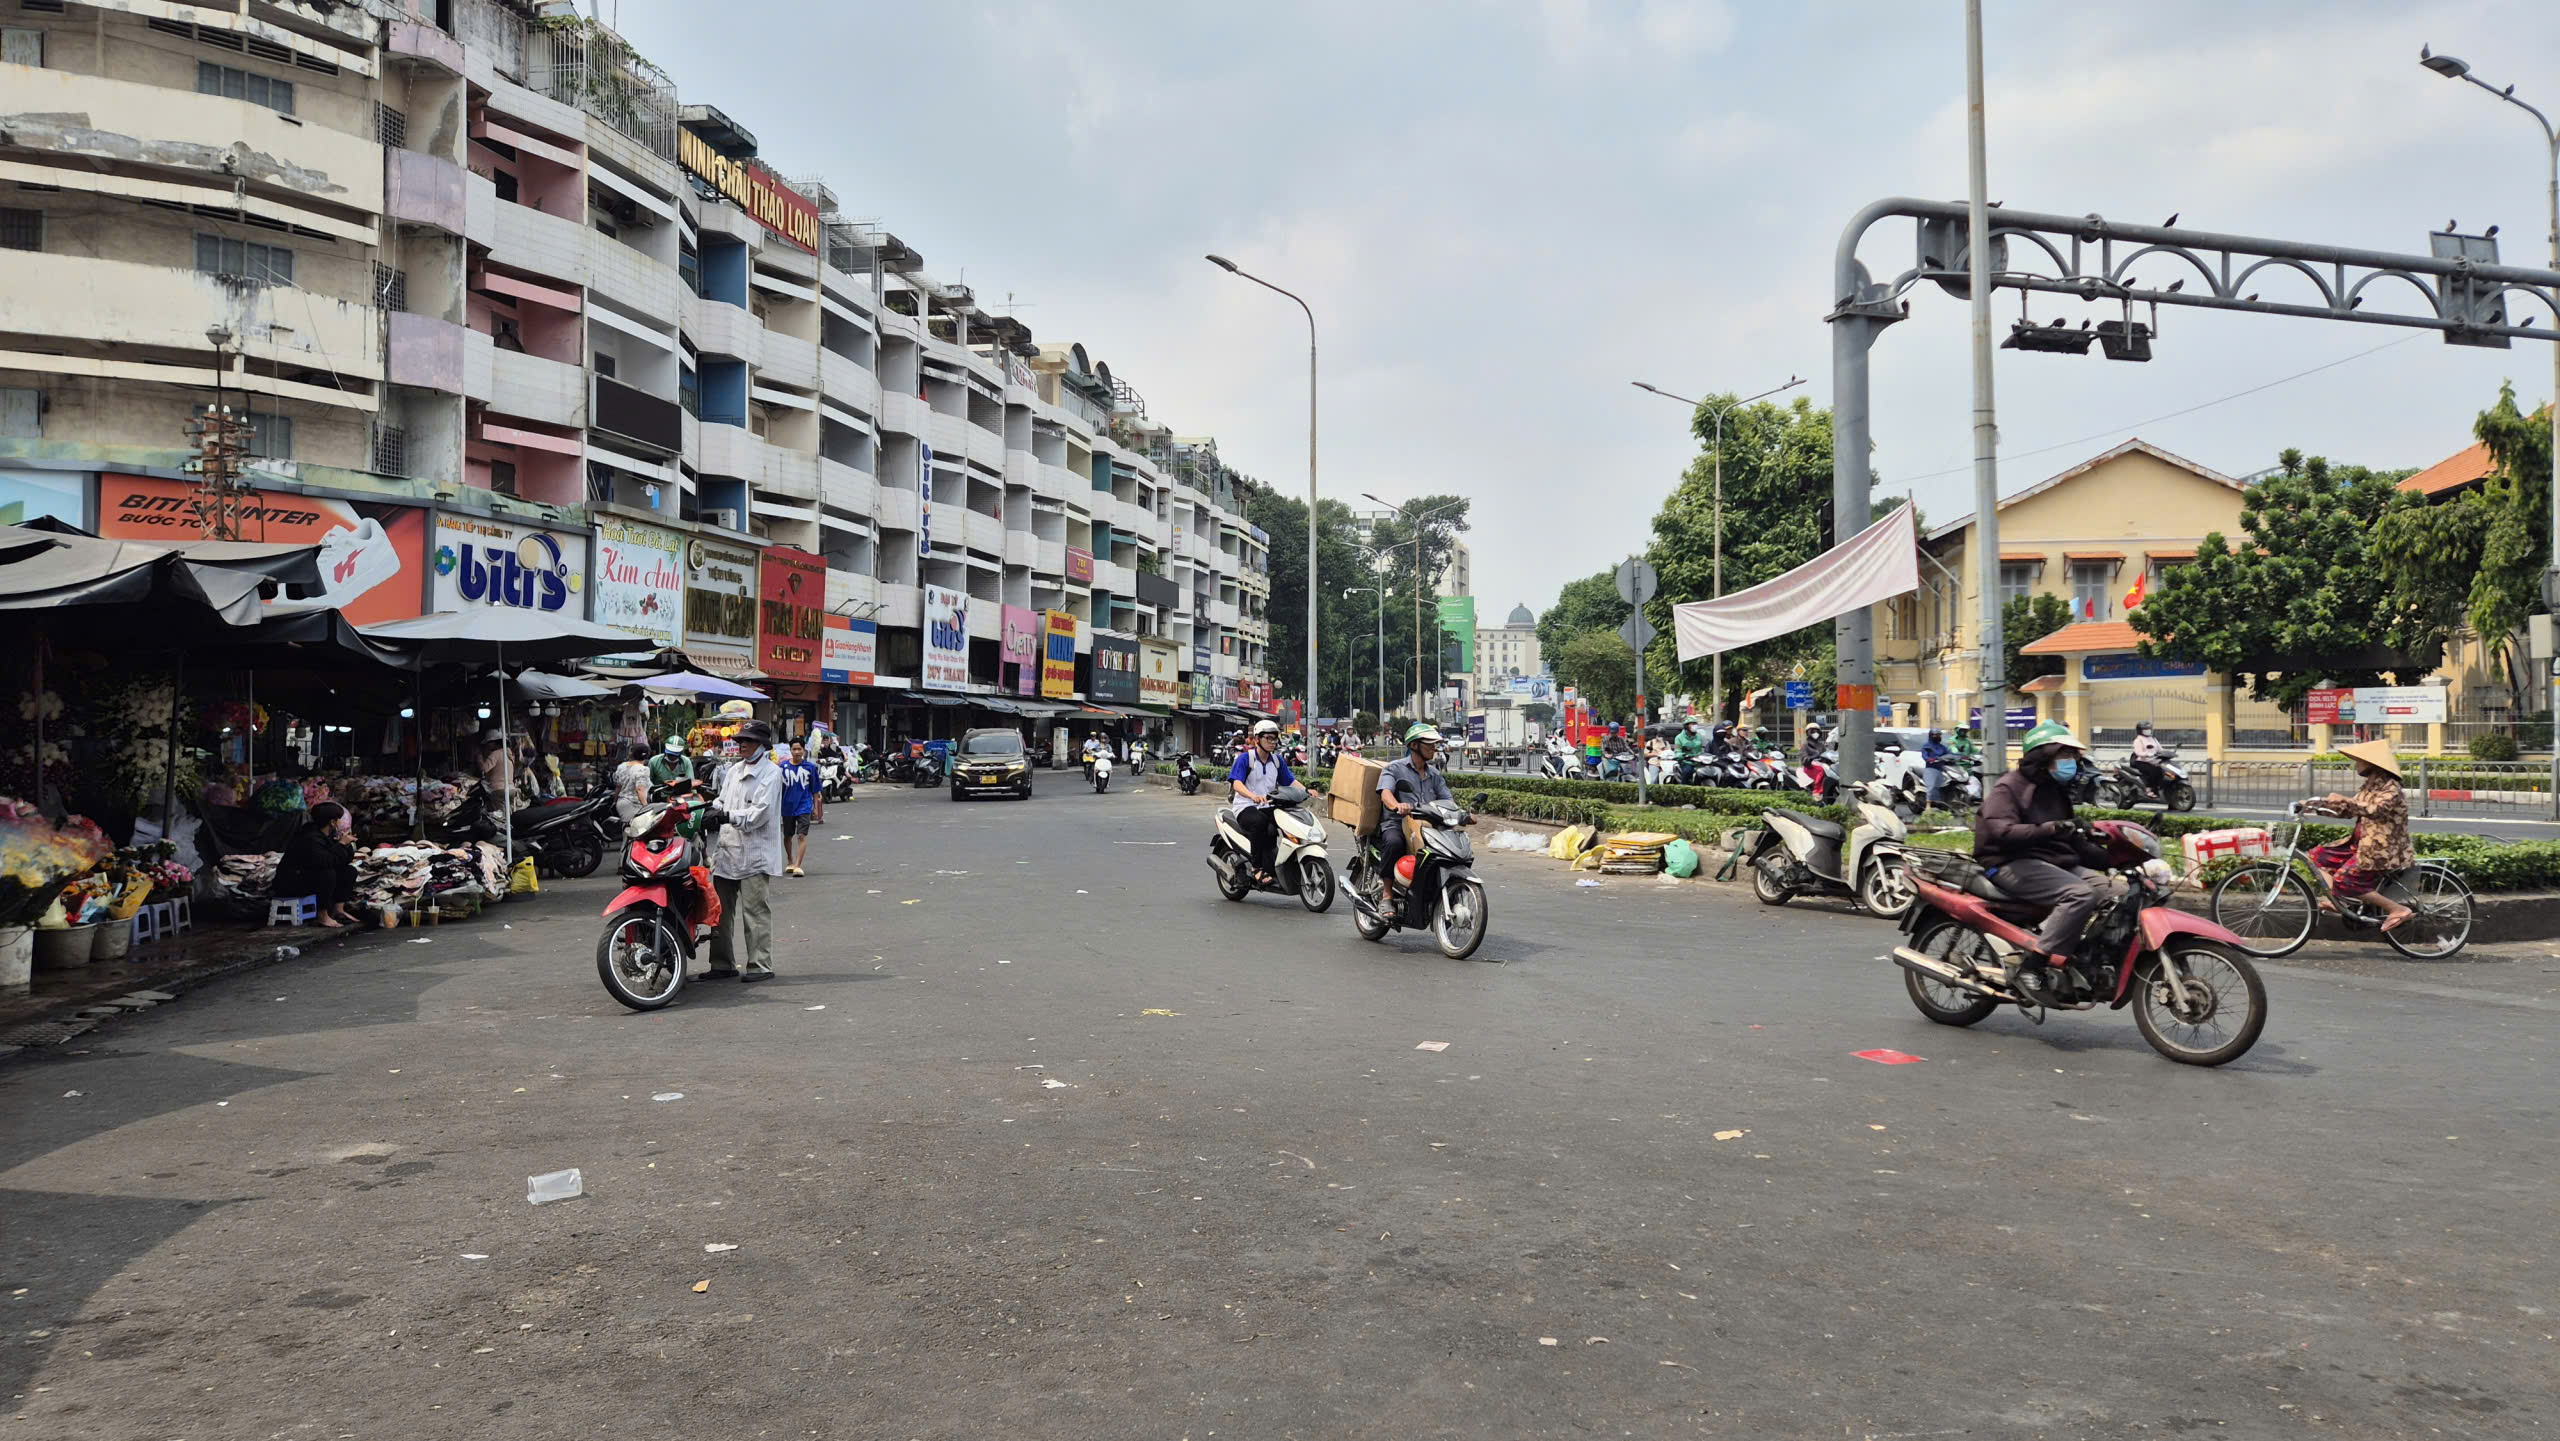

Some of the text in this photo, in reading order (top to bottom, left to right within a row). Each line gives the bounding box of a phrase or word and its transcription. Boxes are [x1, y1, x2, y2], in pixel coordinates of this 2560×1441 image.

[680, 125, 818, 250] MINH CHÂU THẢO LOAN
[602, 523, 624, 542] Hoa
[597, 547, 639, 585] Kim
[644, 557, 680, 592] Anh
